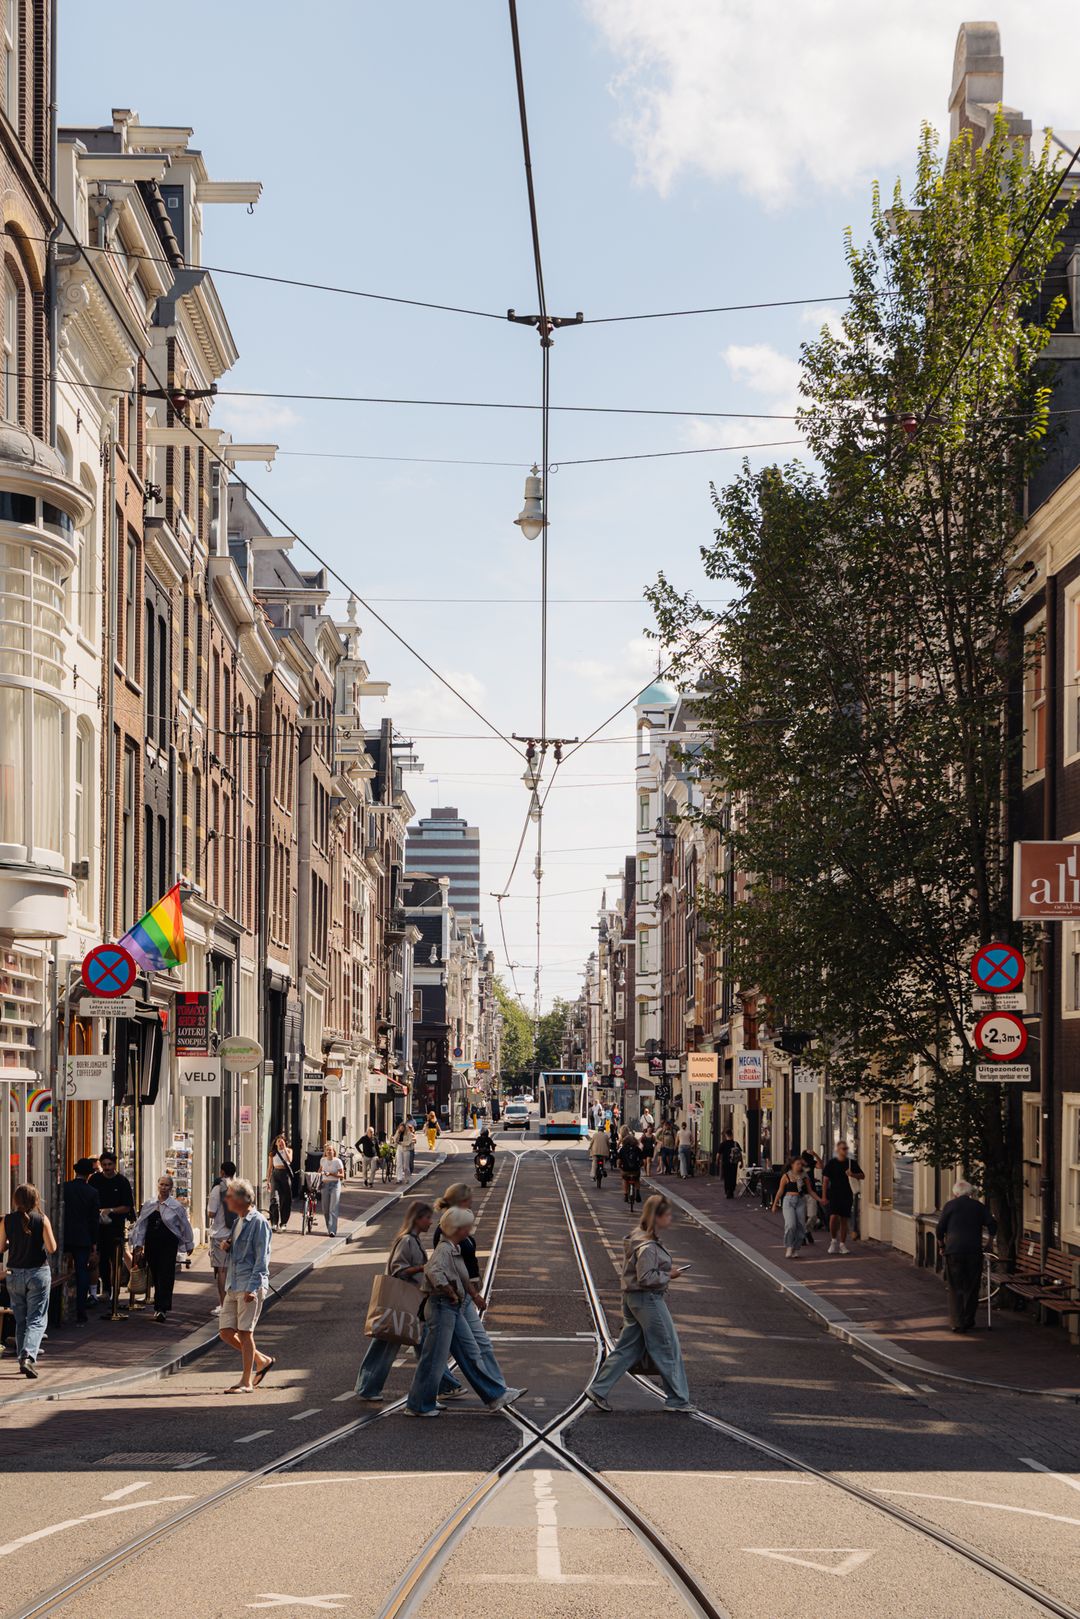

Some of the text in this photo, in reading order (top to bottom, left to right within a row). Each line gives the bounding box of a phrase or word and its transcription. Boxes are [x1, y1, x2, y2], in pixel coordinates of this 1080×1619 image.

[178, 1028, 206, 1037] LOTERIJ
[739, 1056, 761, 1067] MEGHNA
[185, 1072, 216, 1082] VELD
